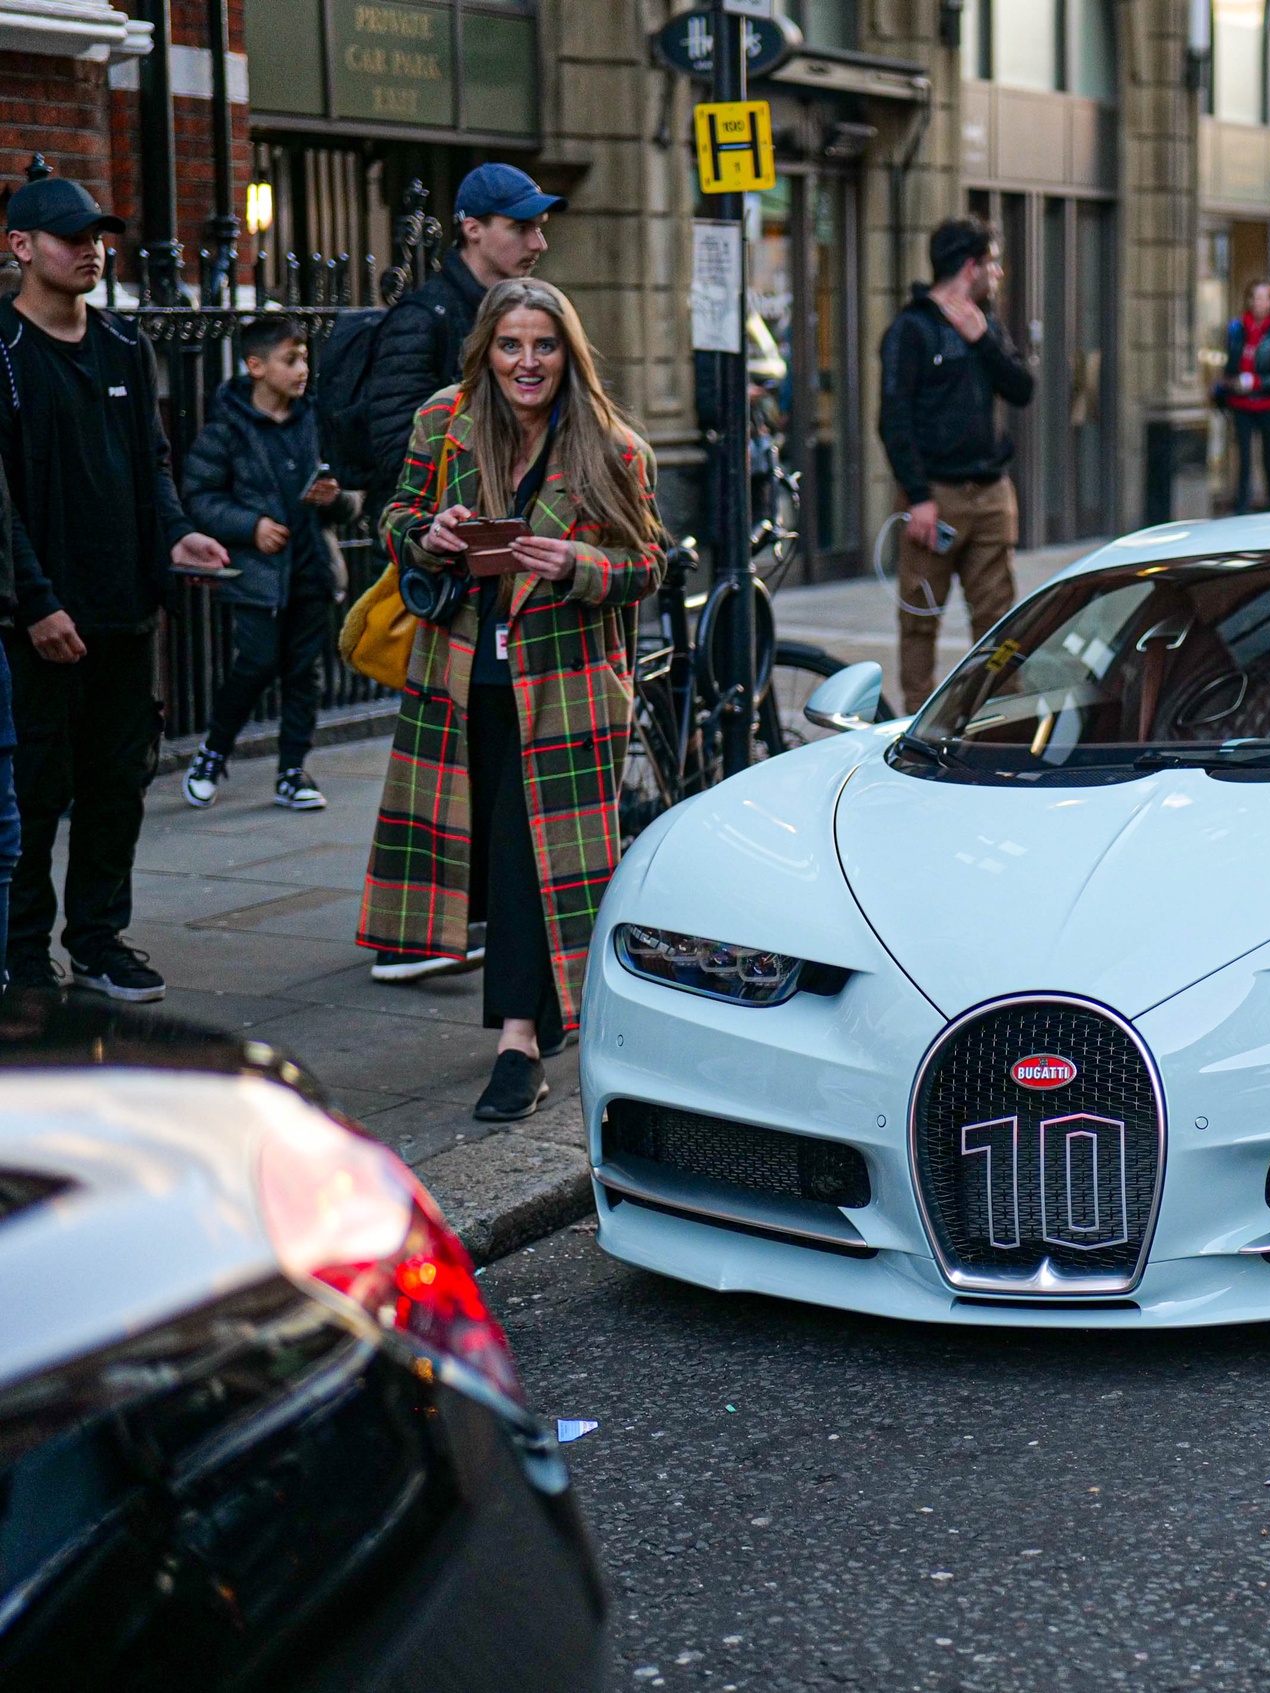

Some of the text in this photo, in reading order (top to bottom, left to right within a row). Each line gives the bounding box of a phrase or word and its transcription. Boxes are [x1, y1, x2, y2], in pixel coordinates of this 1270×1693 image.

[344, 43, 442, 80] CAR PARK
[1017, 1066, 1069, 1080] BUGATTI
[961, 1112, 1128, 1251] 10
